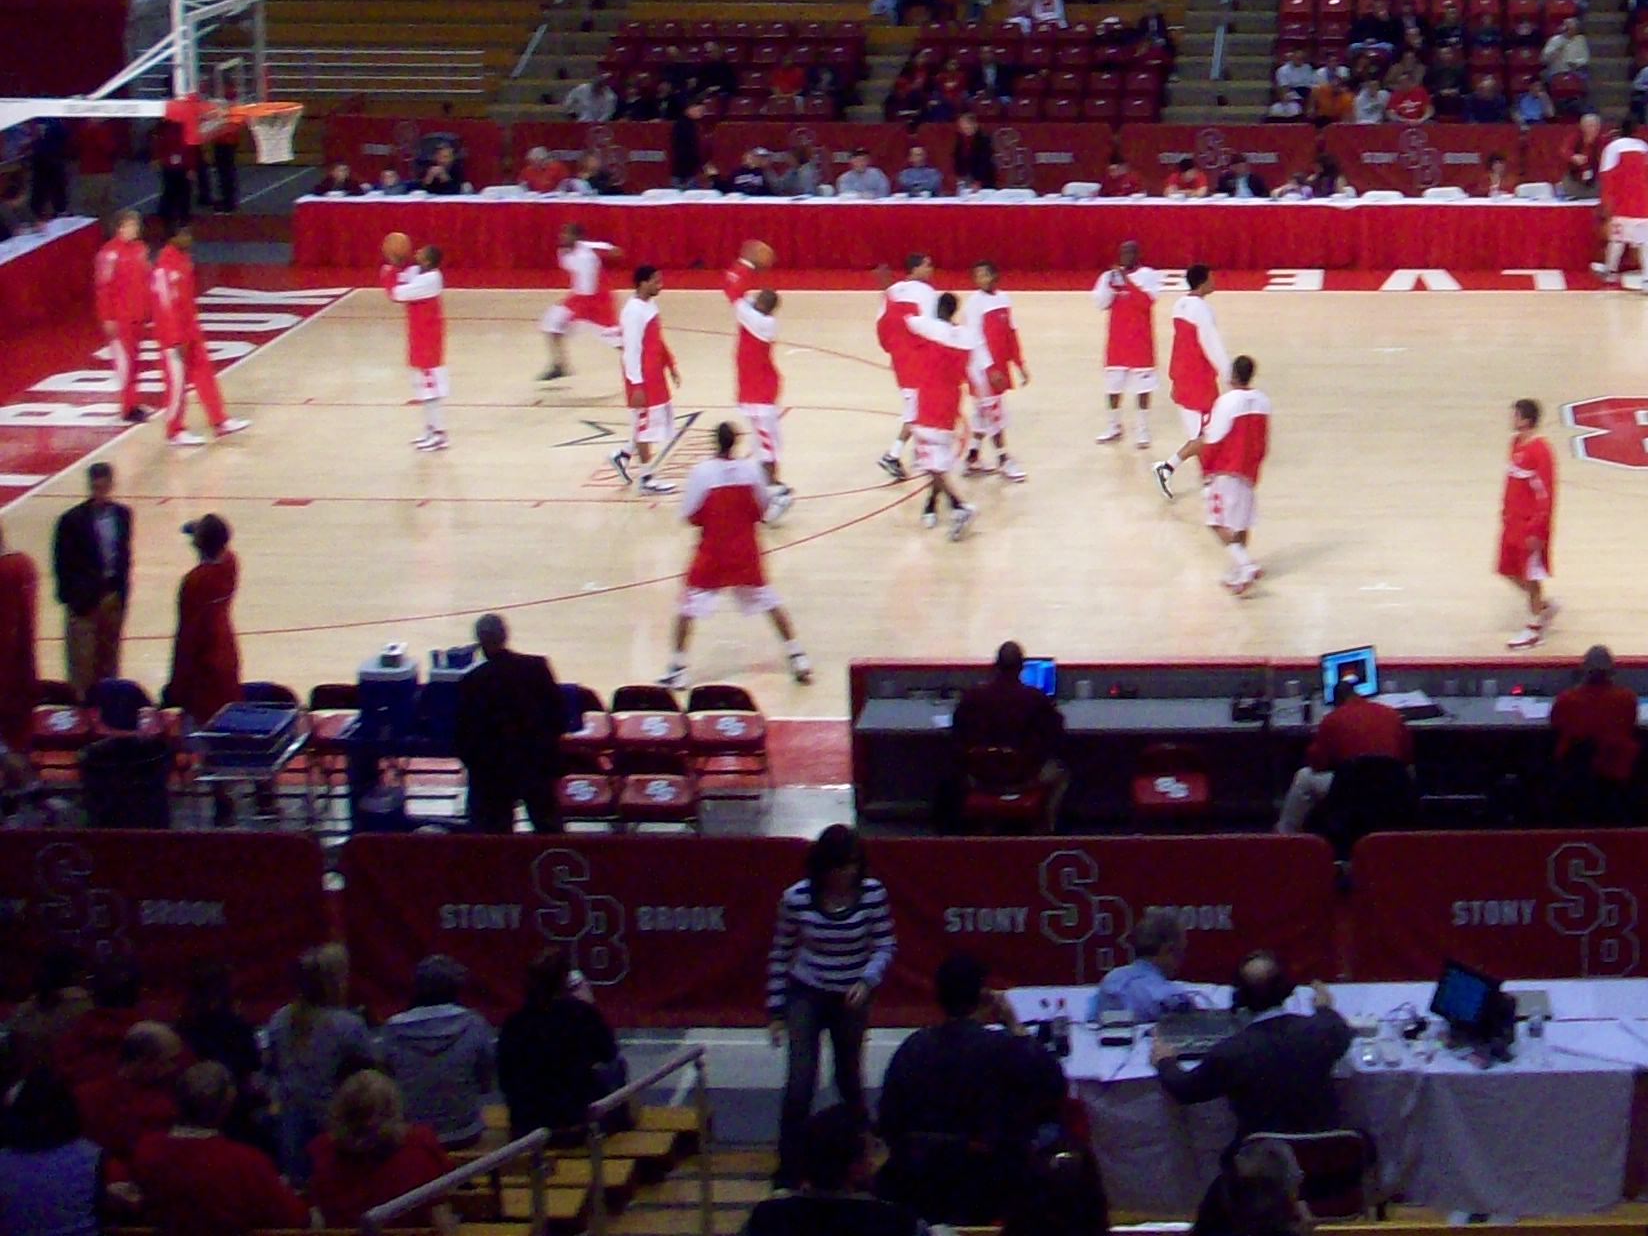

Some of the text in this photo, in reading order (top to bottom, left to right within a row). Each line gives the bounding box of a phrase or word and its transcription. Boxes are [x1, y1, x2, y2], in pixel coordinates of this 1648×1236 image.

[438, 903, 524, 931] STONY
[943, 906, 1029, 934] STONY
[1453, 899, 1537, 926] STONY
